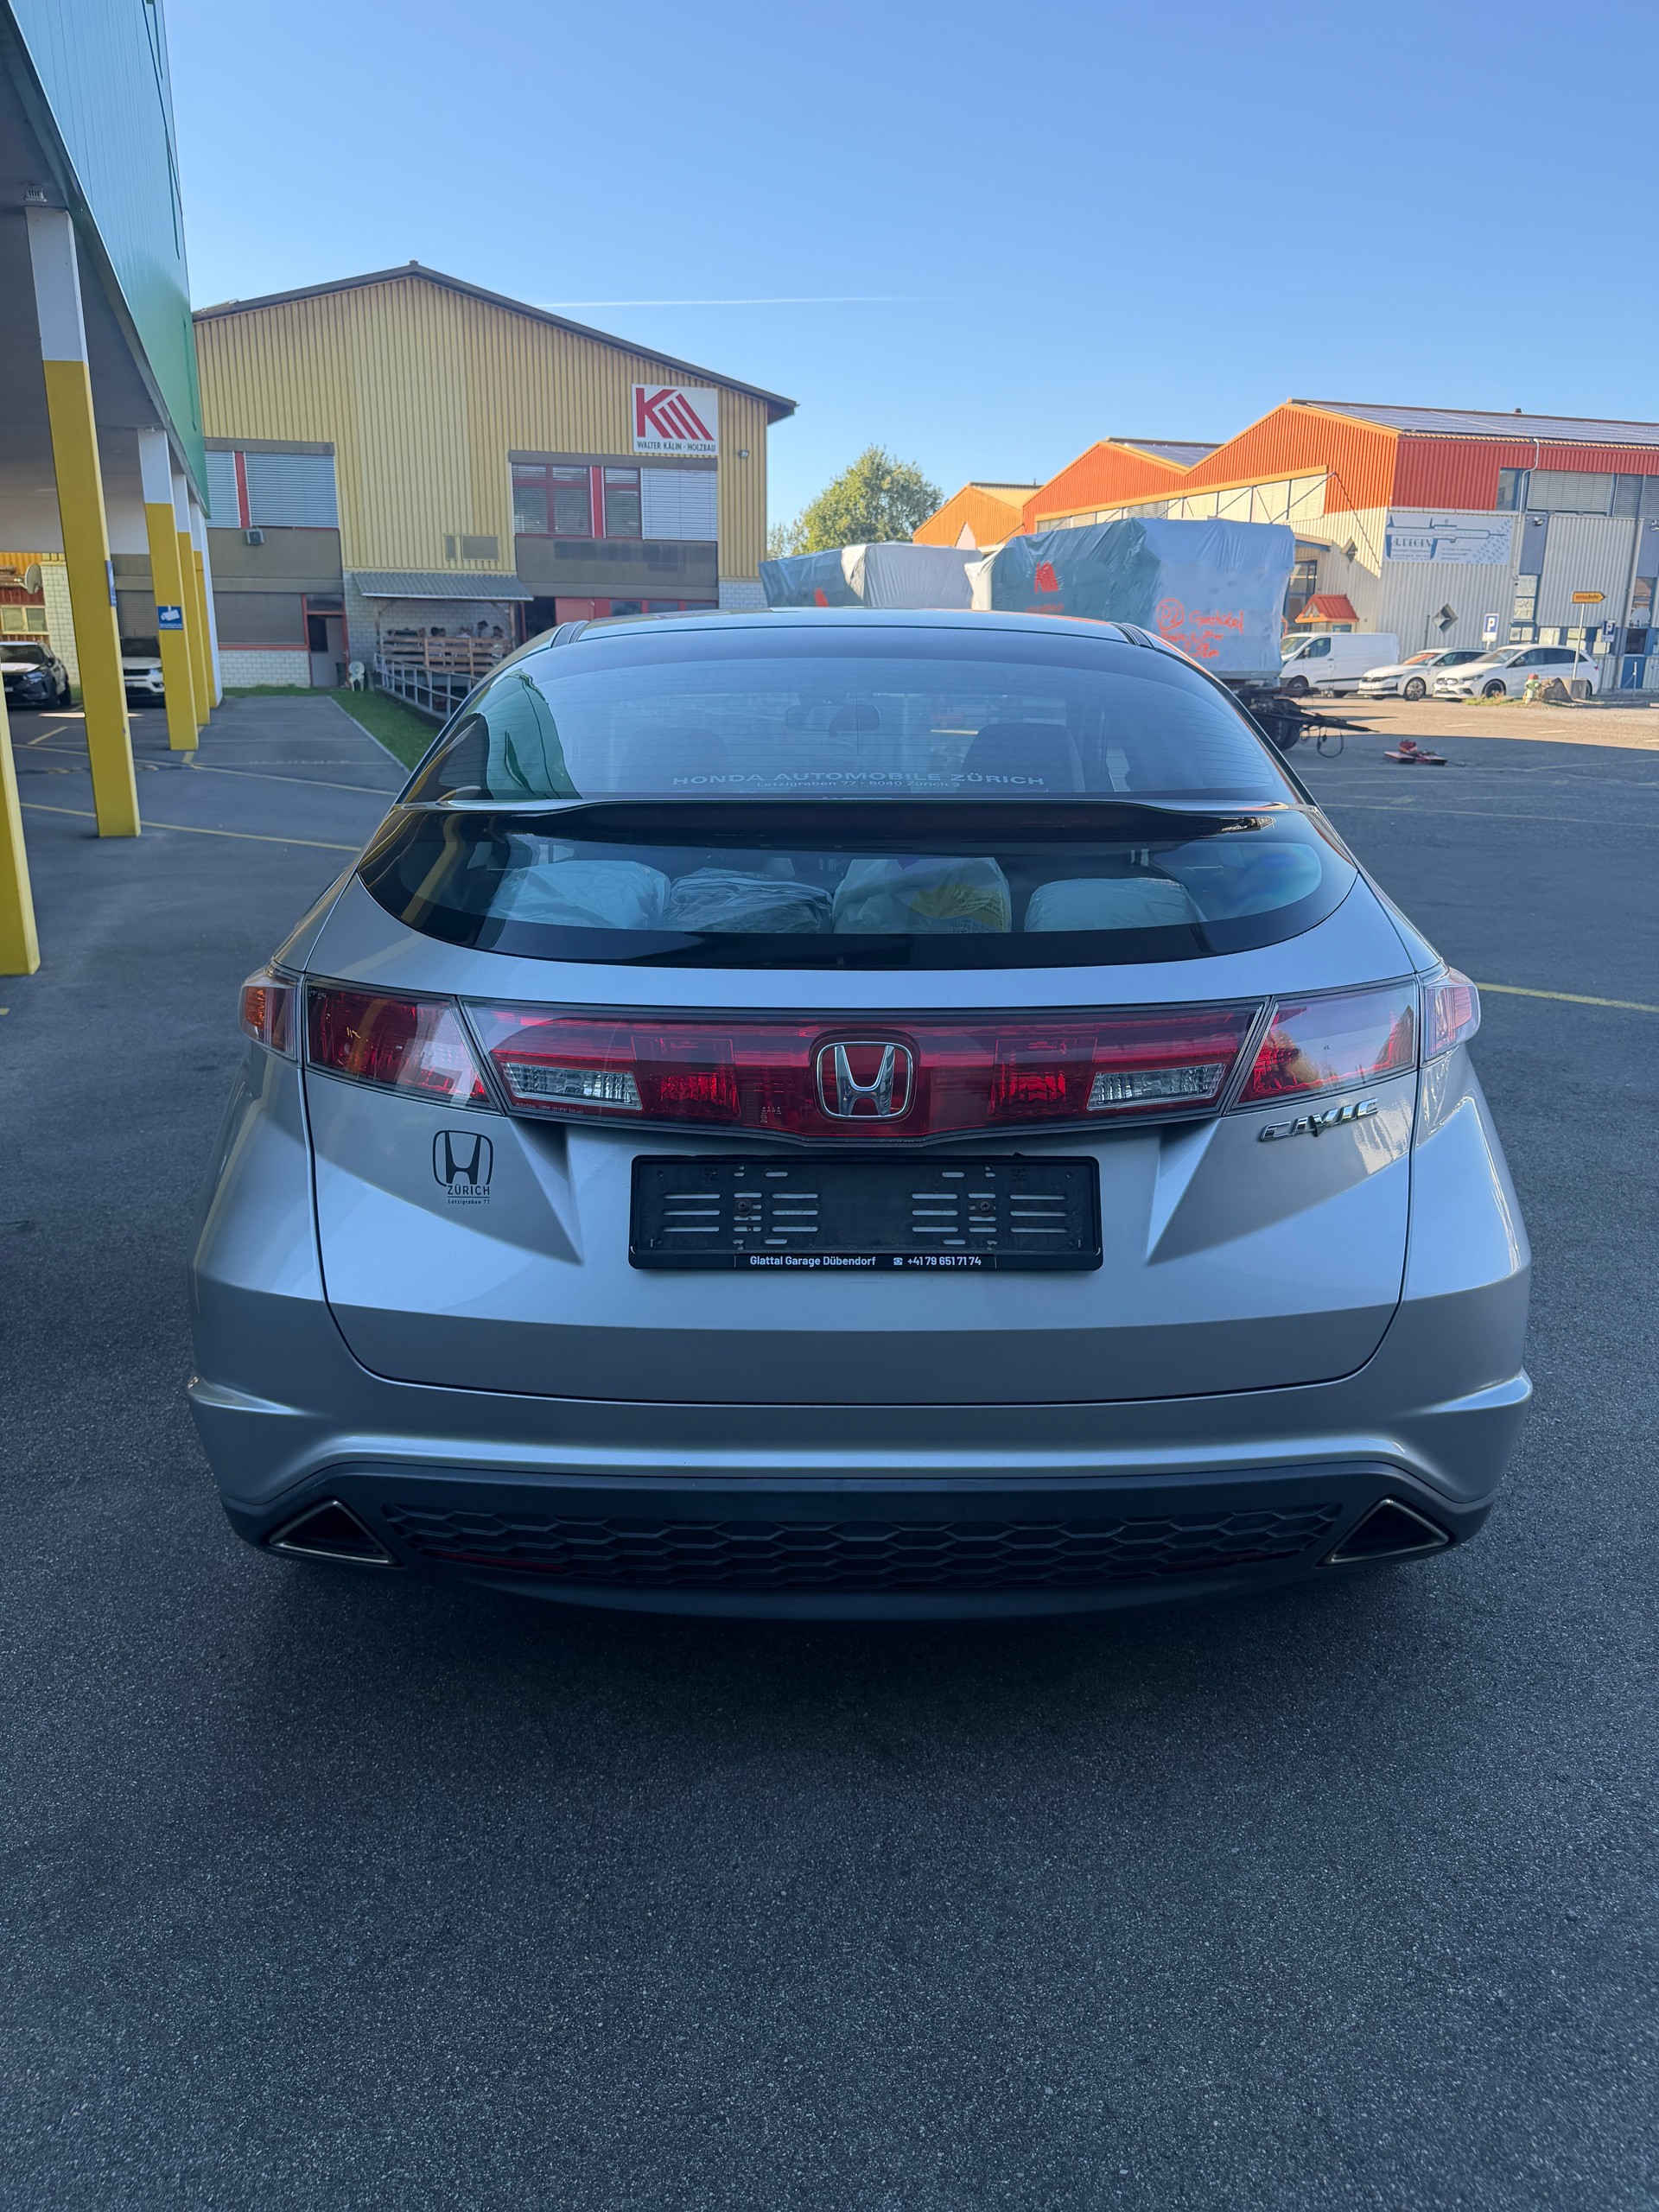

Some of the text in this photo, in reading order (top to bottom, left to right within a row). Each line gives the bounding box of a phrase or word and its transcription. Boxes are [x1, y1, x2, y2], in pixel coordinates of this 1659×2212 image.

[637, 442, 661, 450] WALTER
[664, 442, 682, 450] KÄLIN
[687, 443, 716, 452] HOLZBAU
[672, 772, 1045, 785] HONDA AUTOMOBILE ZÜRICH
[1260, 1096, 1380, 1142] CIVIC
[447, 1184, 491, 1196] ZÜRICH
[749, 1255, 982, 1268] Glattal Garage Dübendorf +41 79 651 71 74
